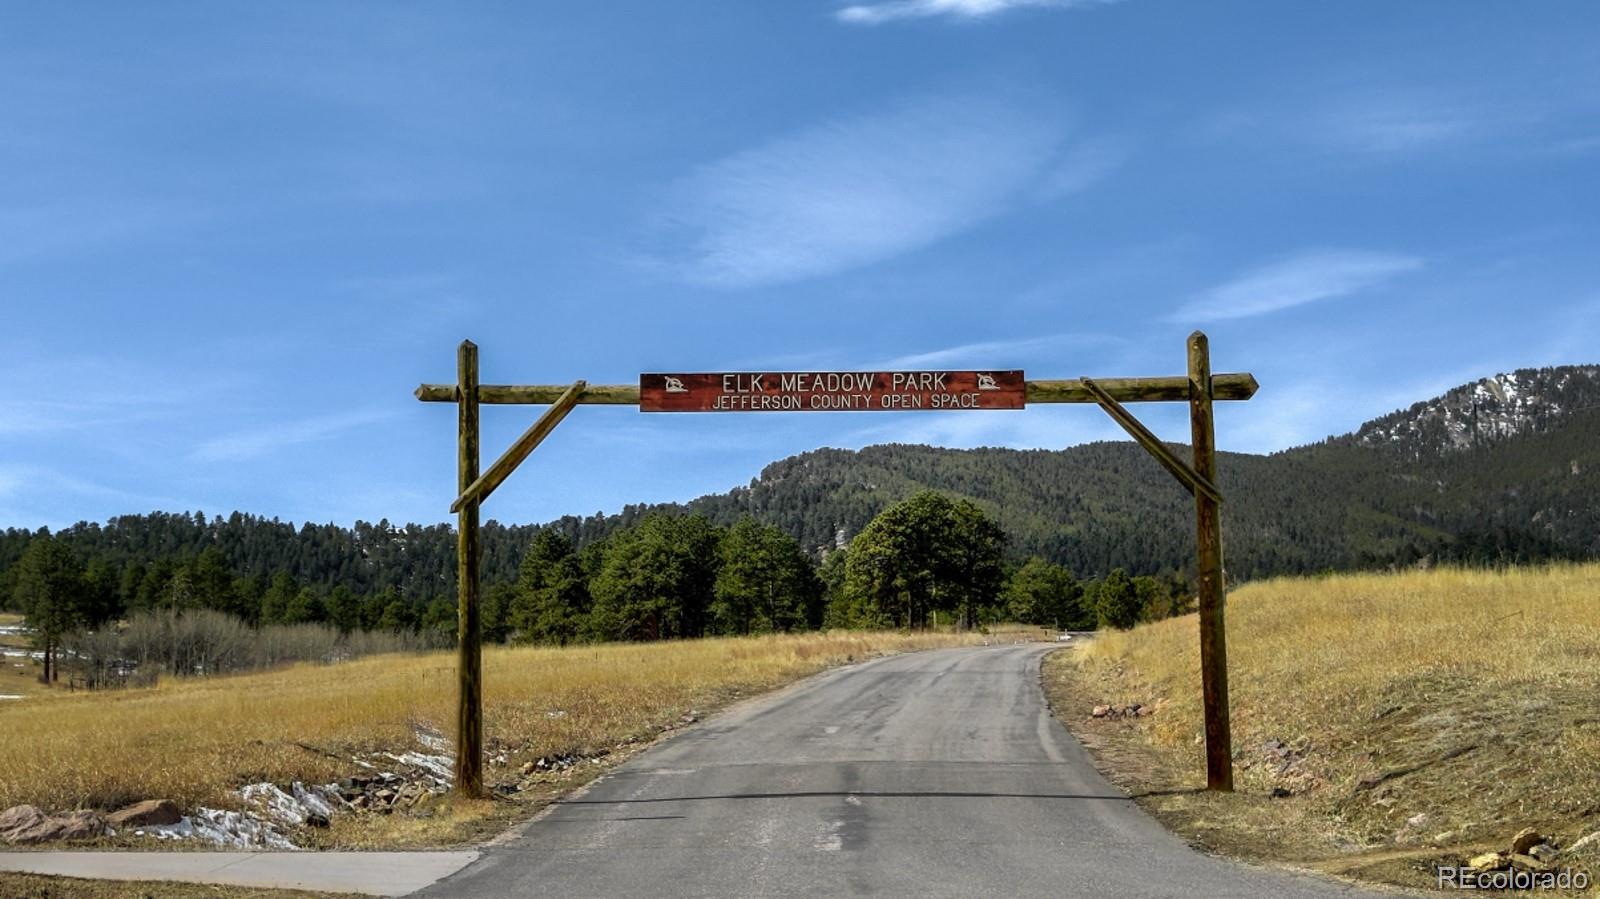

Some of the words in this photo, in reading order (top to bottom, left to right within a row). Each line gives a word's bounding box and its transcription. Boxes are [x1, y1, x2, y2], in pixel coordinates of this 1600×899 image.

[722, 374, 764, 393] ELK
[781, 373, 875, 392] MEADOW
[893, 373, 947, 391] PARK
[712, 395, 802, 409] JEFFERSON
[810, 395, 873, 409] COUNTY
[881, 394, 922, 408] OPEN
[930, 393, 981, 408] SPACE
